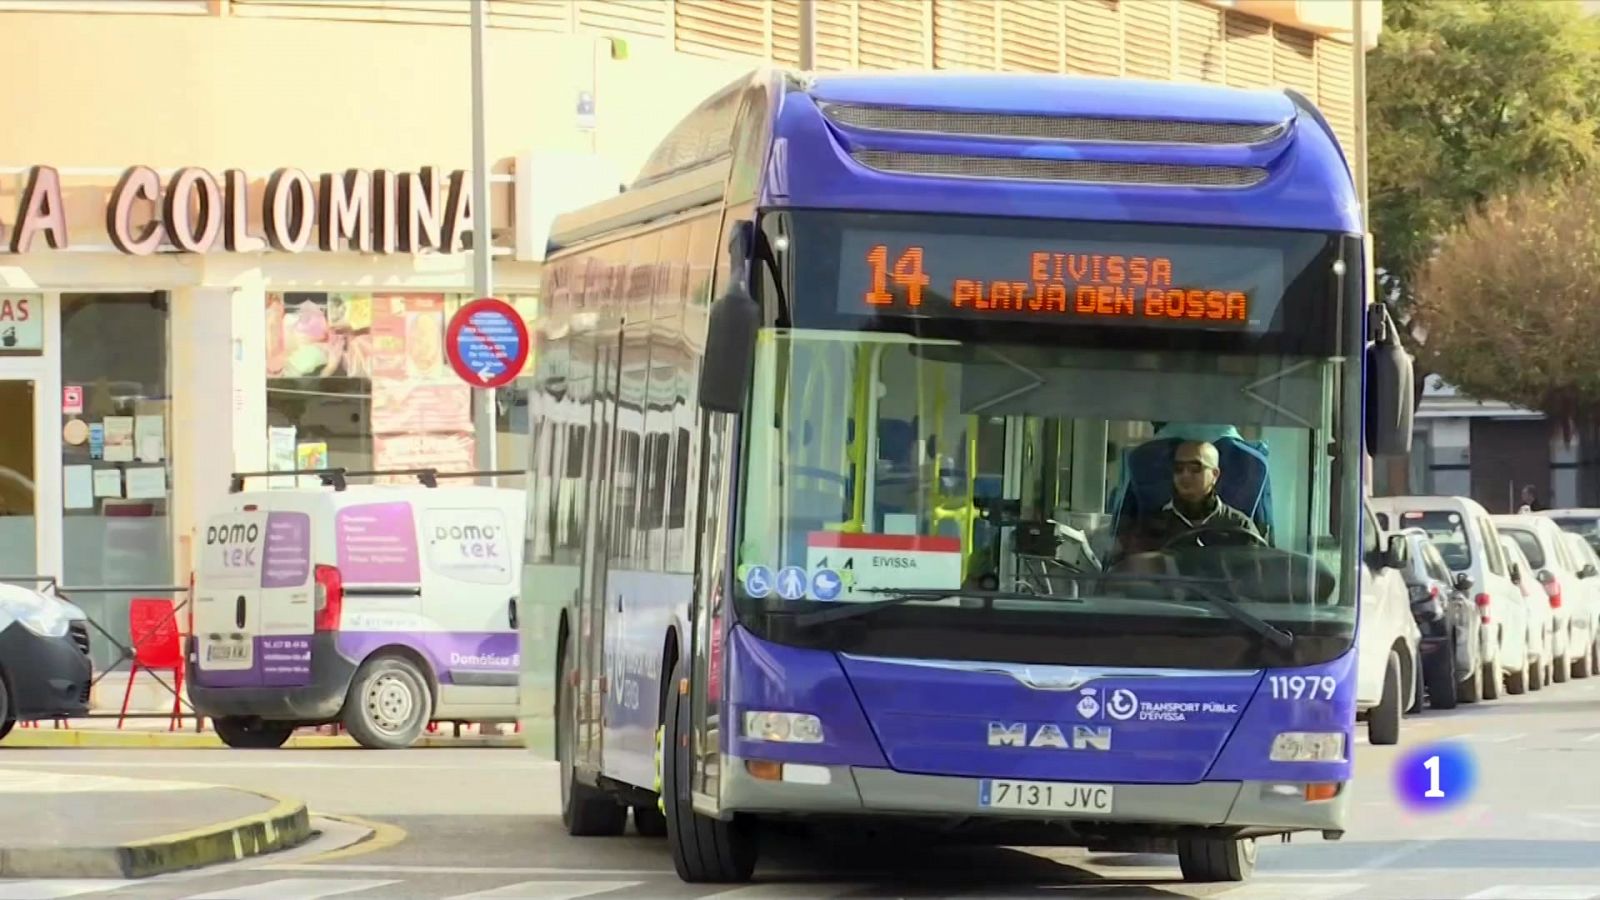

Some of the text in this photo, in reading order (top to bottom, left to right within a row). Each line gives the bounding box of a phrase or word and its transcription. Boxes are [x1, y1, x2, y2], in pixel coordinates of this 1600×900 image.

[0, 164, 475, 256] A COLOMINA
[864, 244, 931, 307] 14
[1031, 252, 1172, 285] EIVISSA
[954, 280, 1248, 320] PLATJA DEN BOSSA
[872, 555, 917, 568] EIVISSA
[1270, 675, 1336, 701] 11979
[1139, 702, 1239, 714] TRANSPORT PÚBLIC
[1139, 711, 1186, 721] D'EIVISSA
[986, 722, 1112, 751] MAN
[995, 783, 1107, 812] 7131 JVC
